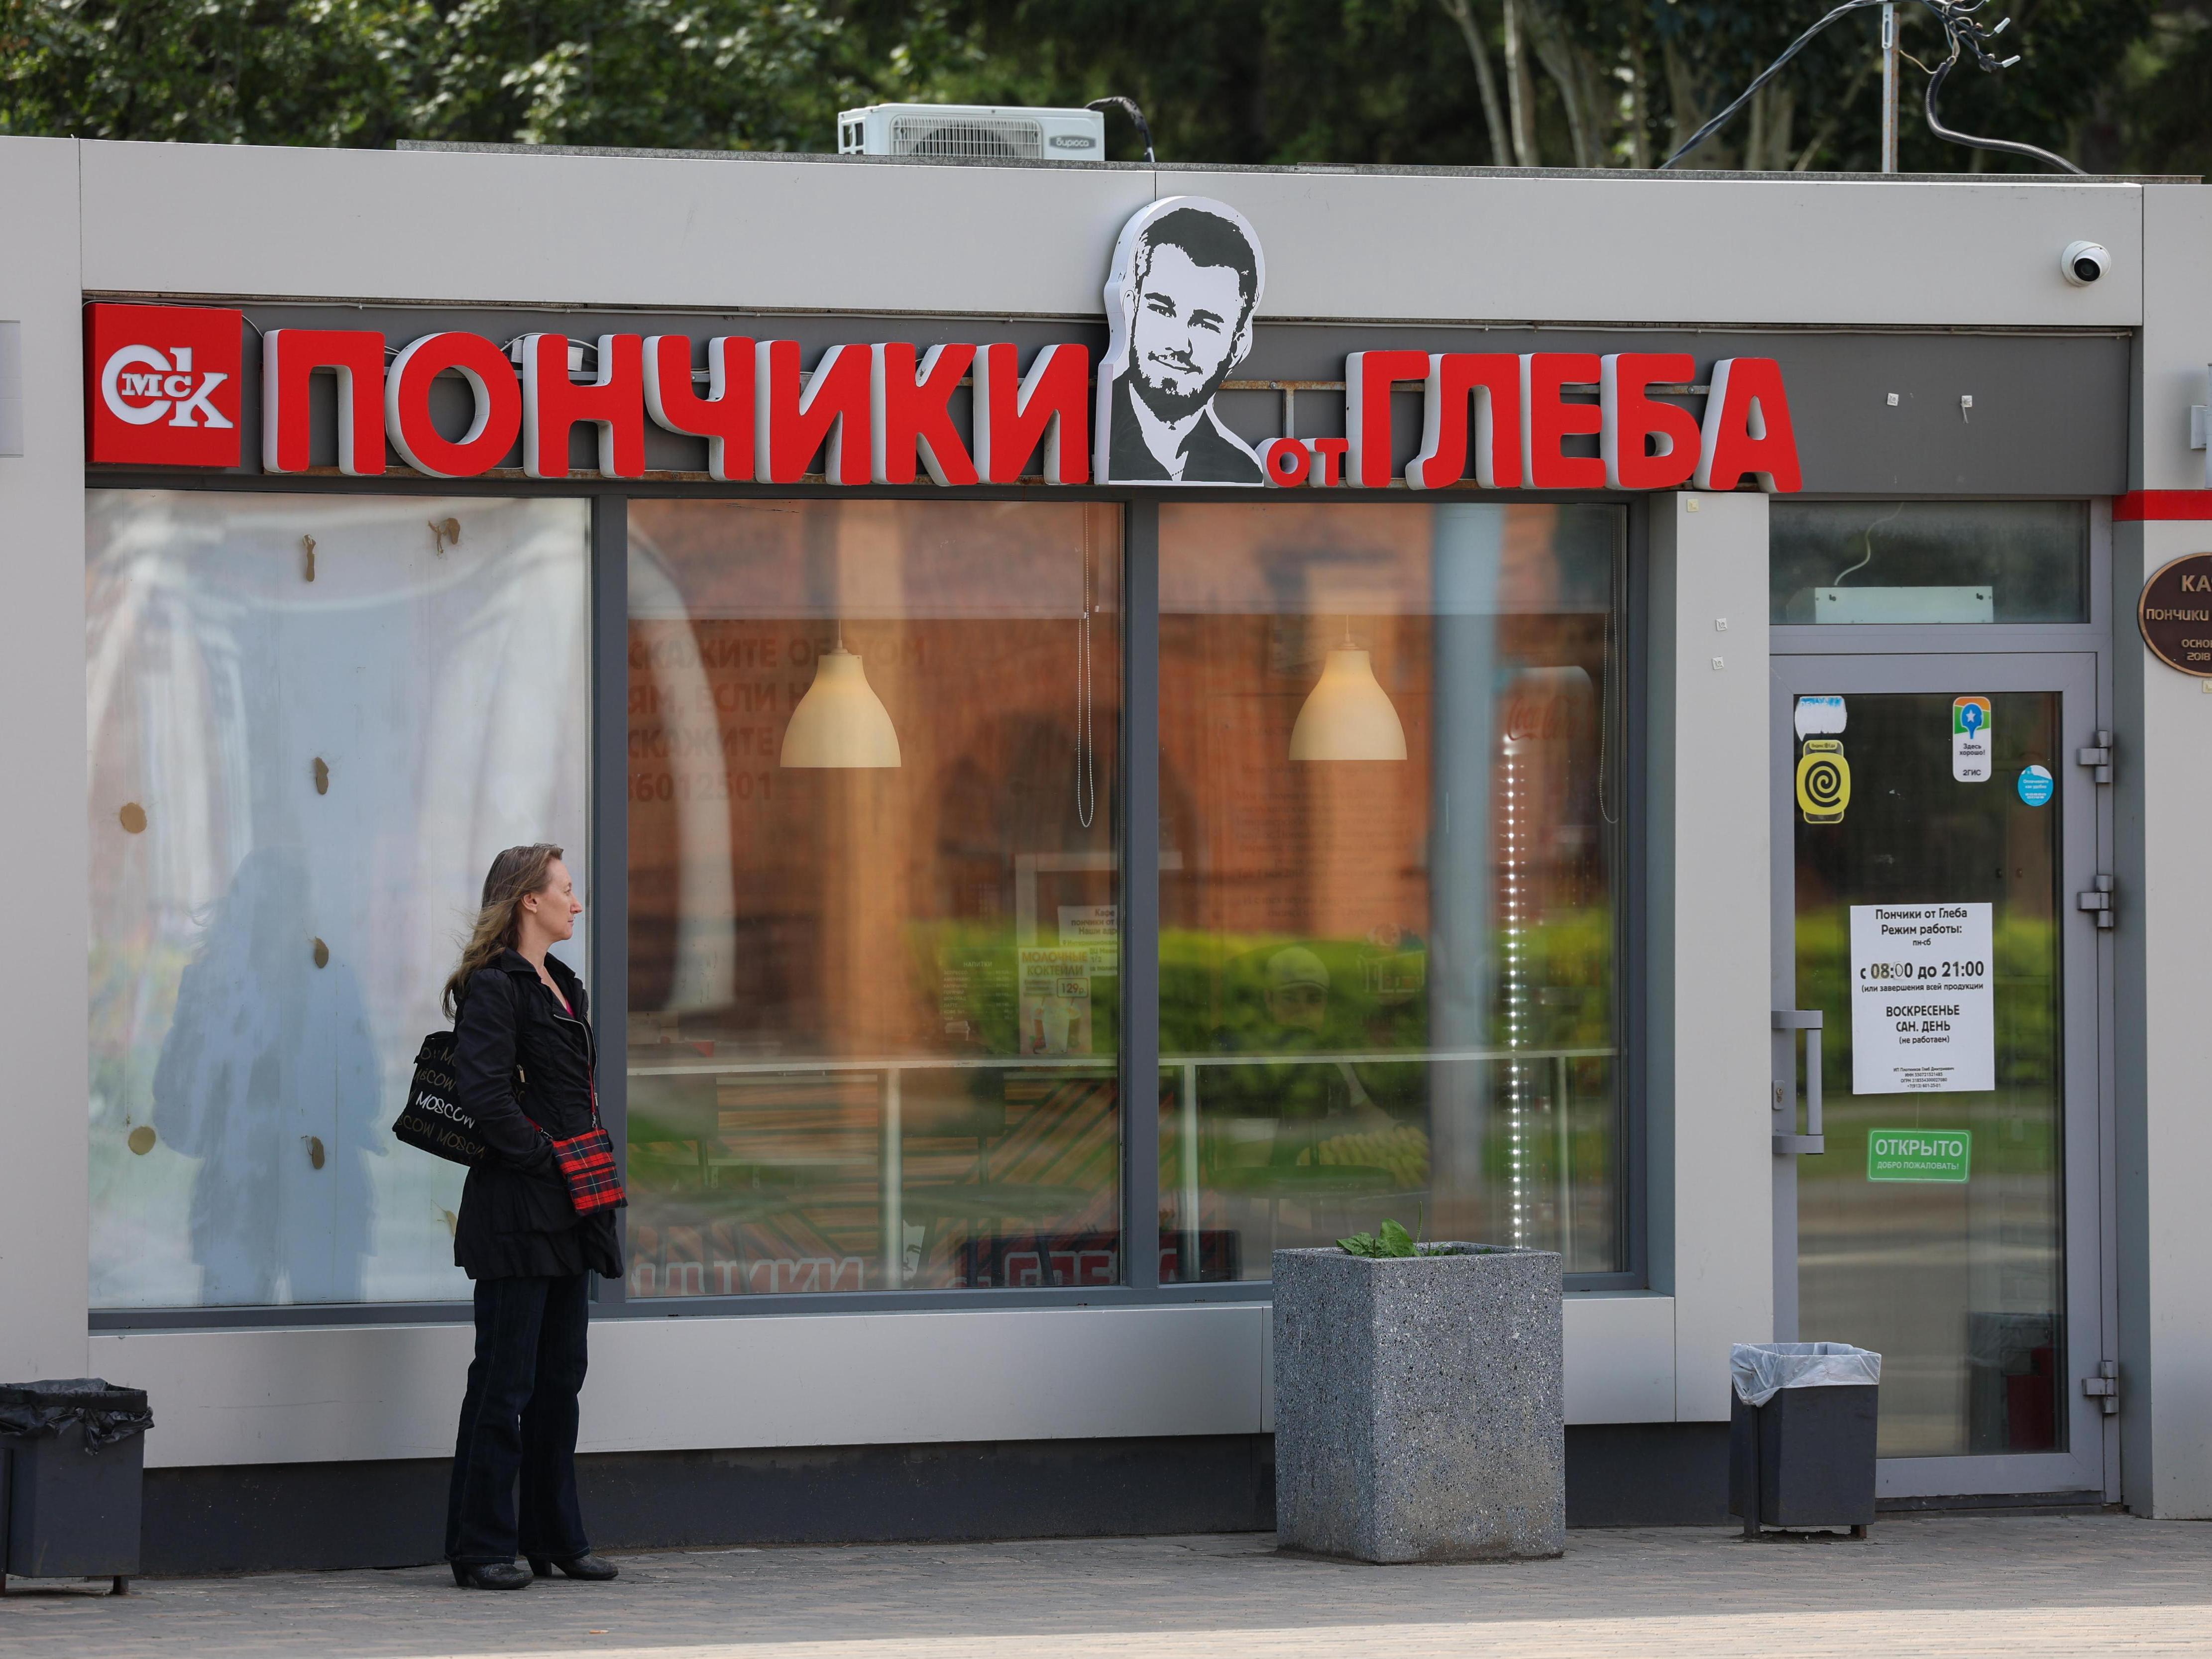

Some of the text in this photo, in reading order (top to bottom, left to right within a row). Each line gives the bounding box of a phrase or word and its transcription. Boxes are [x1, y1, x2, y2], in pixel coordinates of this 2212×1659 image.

[1056, 136, 1090, 149] бирюса
[263, 329, 1802, 493] ПОНЧИКИ от ГЛЕБА
[2182, 575, 2212, 592] КА
[2146, 609, 2208, 621] ПОНЧИКИ
[2182, 639, 2212, 648] ОСНО
[1876, 907, 1967, 920] Пончики от Глеба
[1881, 923, 1962, 935] Режим работы:
[1022, 952, 1088, 963] МОЛОЧНЫЕ
[1028, 964, 1084, 976] КОКТЕЙЛИ
[1861, 961, 1984, 980] с 08:00 до 21:00
[1944, 983, 1984, 992] продукции
[1886, 1004, 1960, 1017] ВОСКРЕСЕНЬЕ
[1896, 1020, 1951, 1033] САН. ДЕНЬ
[1912, 1035, 1950, 1044] работаем)
[416, 1091, 475, 1129] MOSCOW
[1876, 1139, 1963, 1157] ОТКРЫТО
[1903, 1161, 1959, 1170] ПОЖАЛОВАТЬ!
